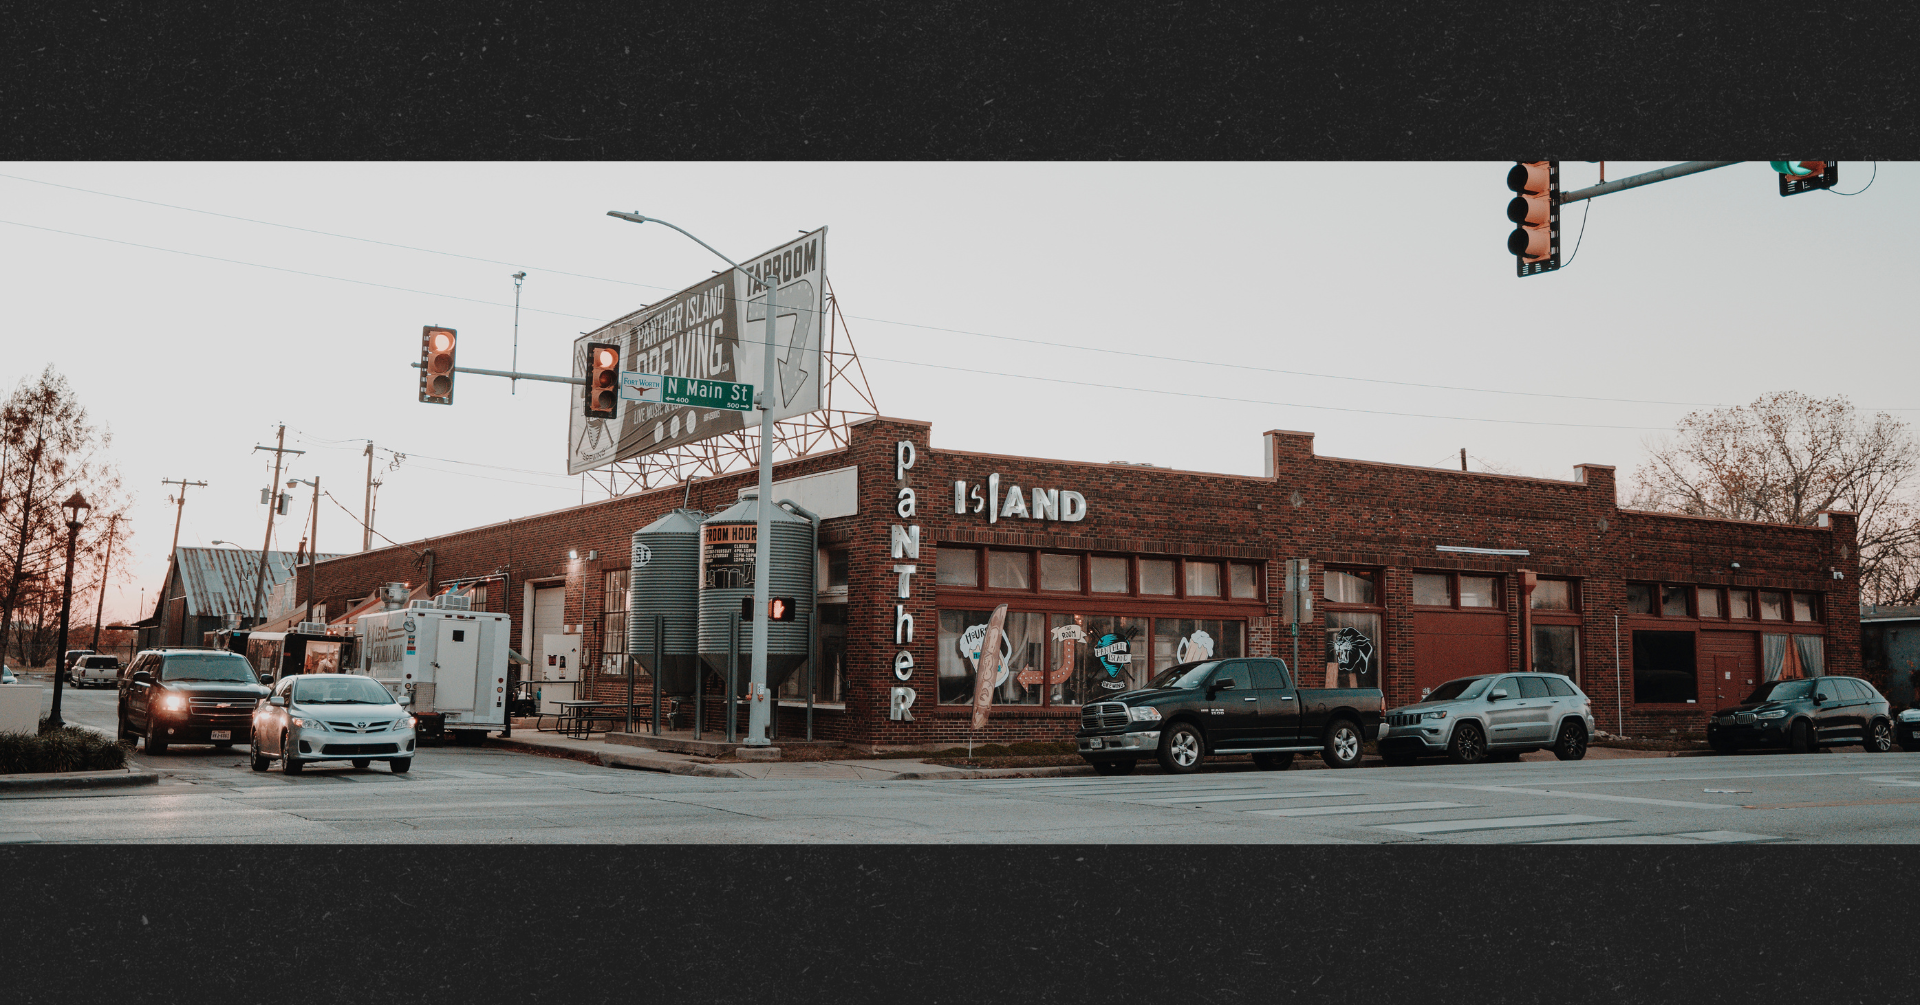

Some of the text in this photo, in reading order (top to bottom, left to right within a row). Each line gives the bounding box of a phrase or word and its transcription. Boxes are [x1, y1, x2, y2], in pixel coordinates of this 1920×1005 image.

[746, 238, 817, 297] TAPROOM
[637, 283, 725, 352] PANTHER ISLAND
[623, 377, 660, 388] FORT WORTH
[668, 378, 748, 402] N Main St
[732, 527, 757, 541] HOUR
